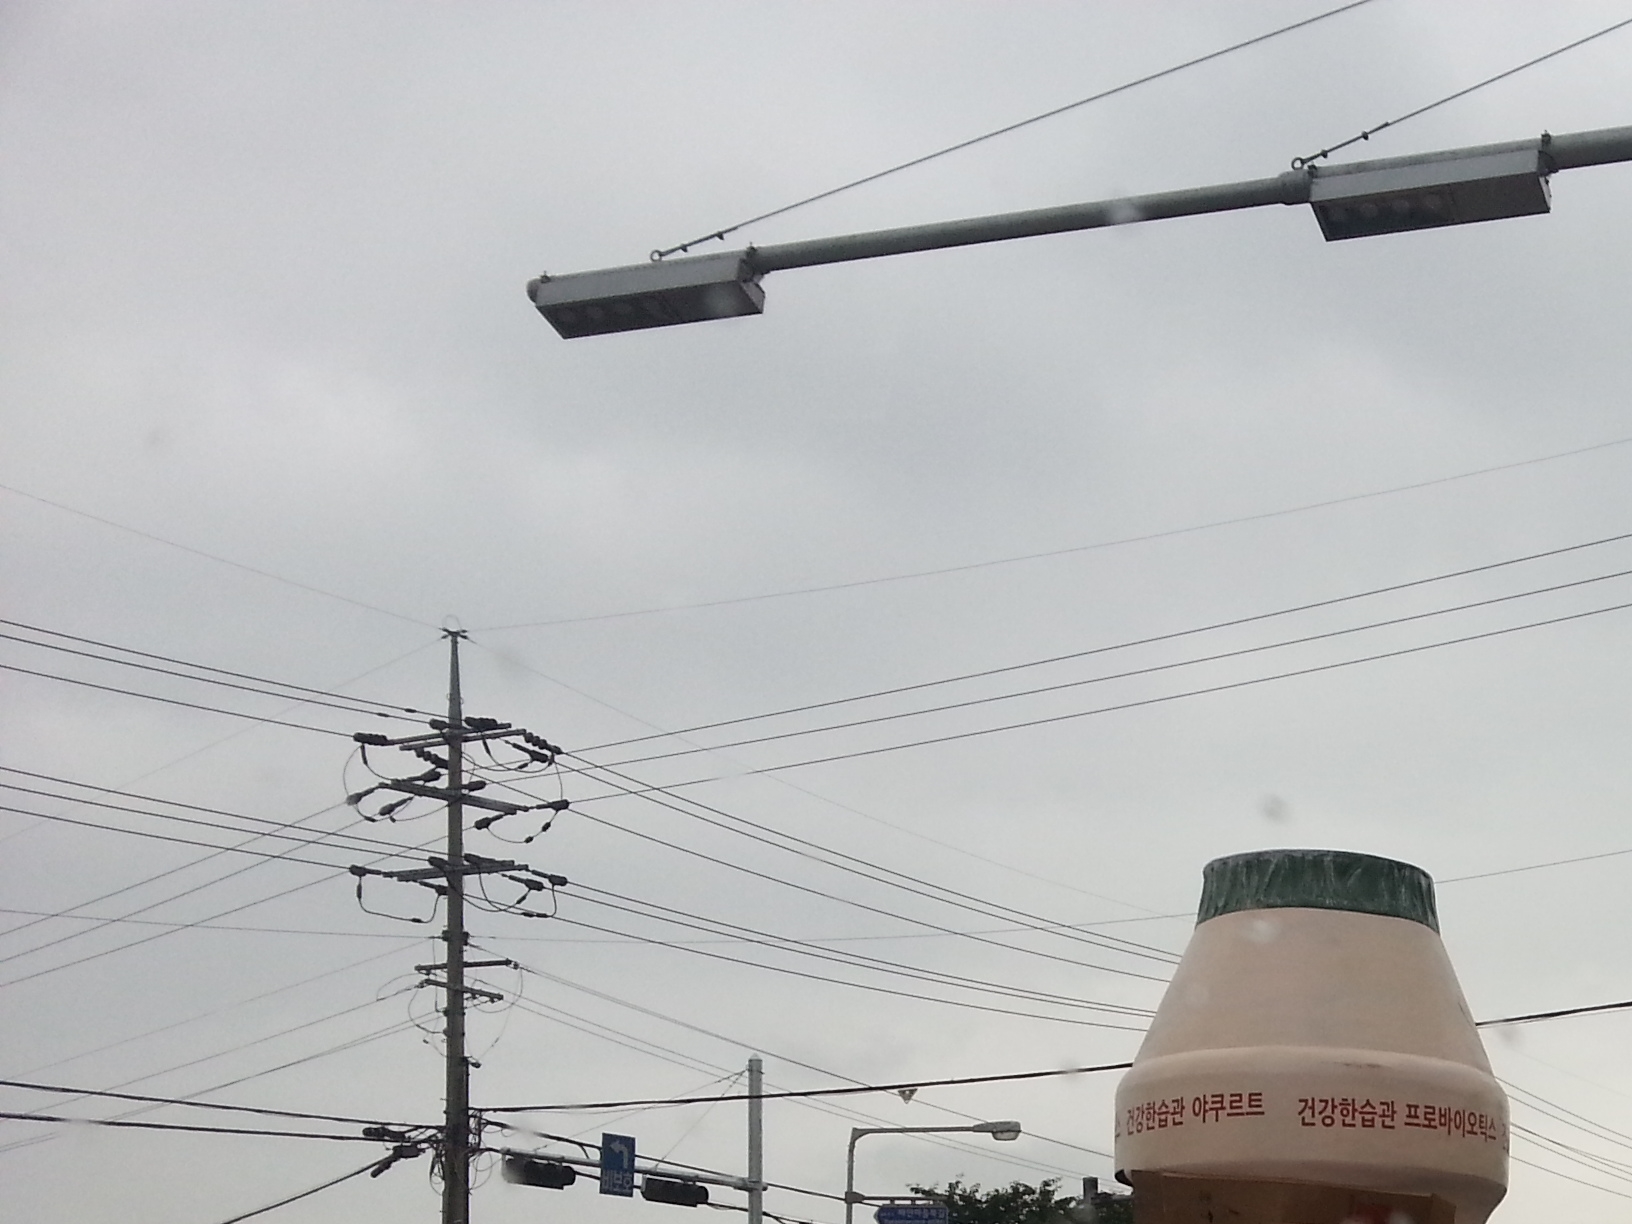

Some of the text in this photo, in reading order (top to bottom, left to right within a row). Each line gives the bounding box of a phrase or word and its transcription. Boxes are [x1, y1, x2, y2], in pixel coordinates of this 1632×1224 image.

[1126, 1096, 1186, 1136] 건강한습관
[1192, 1092, 1265, 1123] 야쿠르트
[1297, 1097, 1398, 1129] 건강한습관
[1404, 1103, 1497, 1142] 프로바이오틱스
